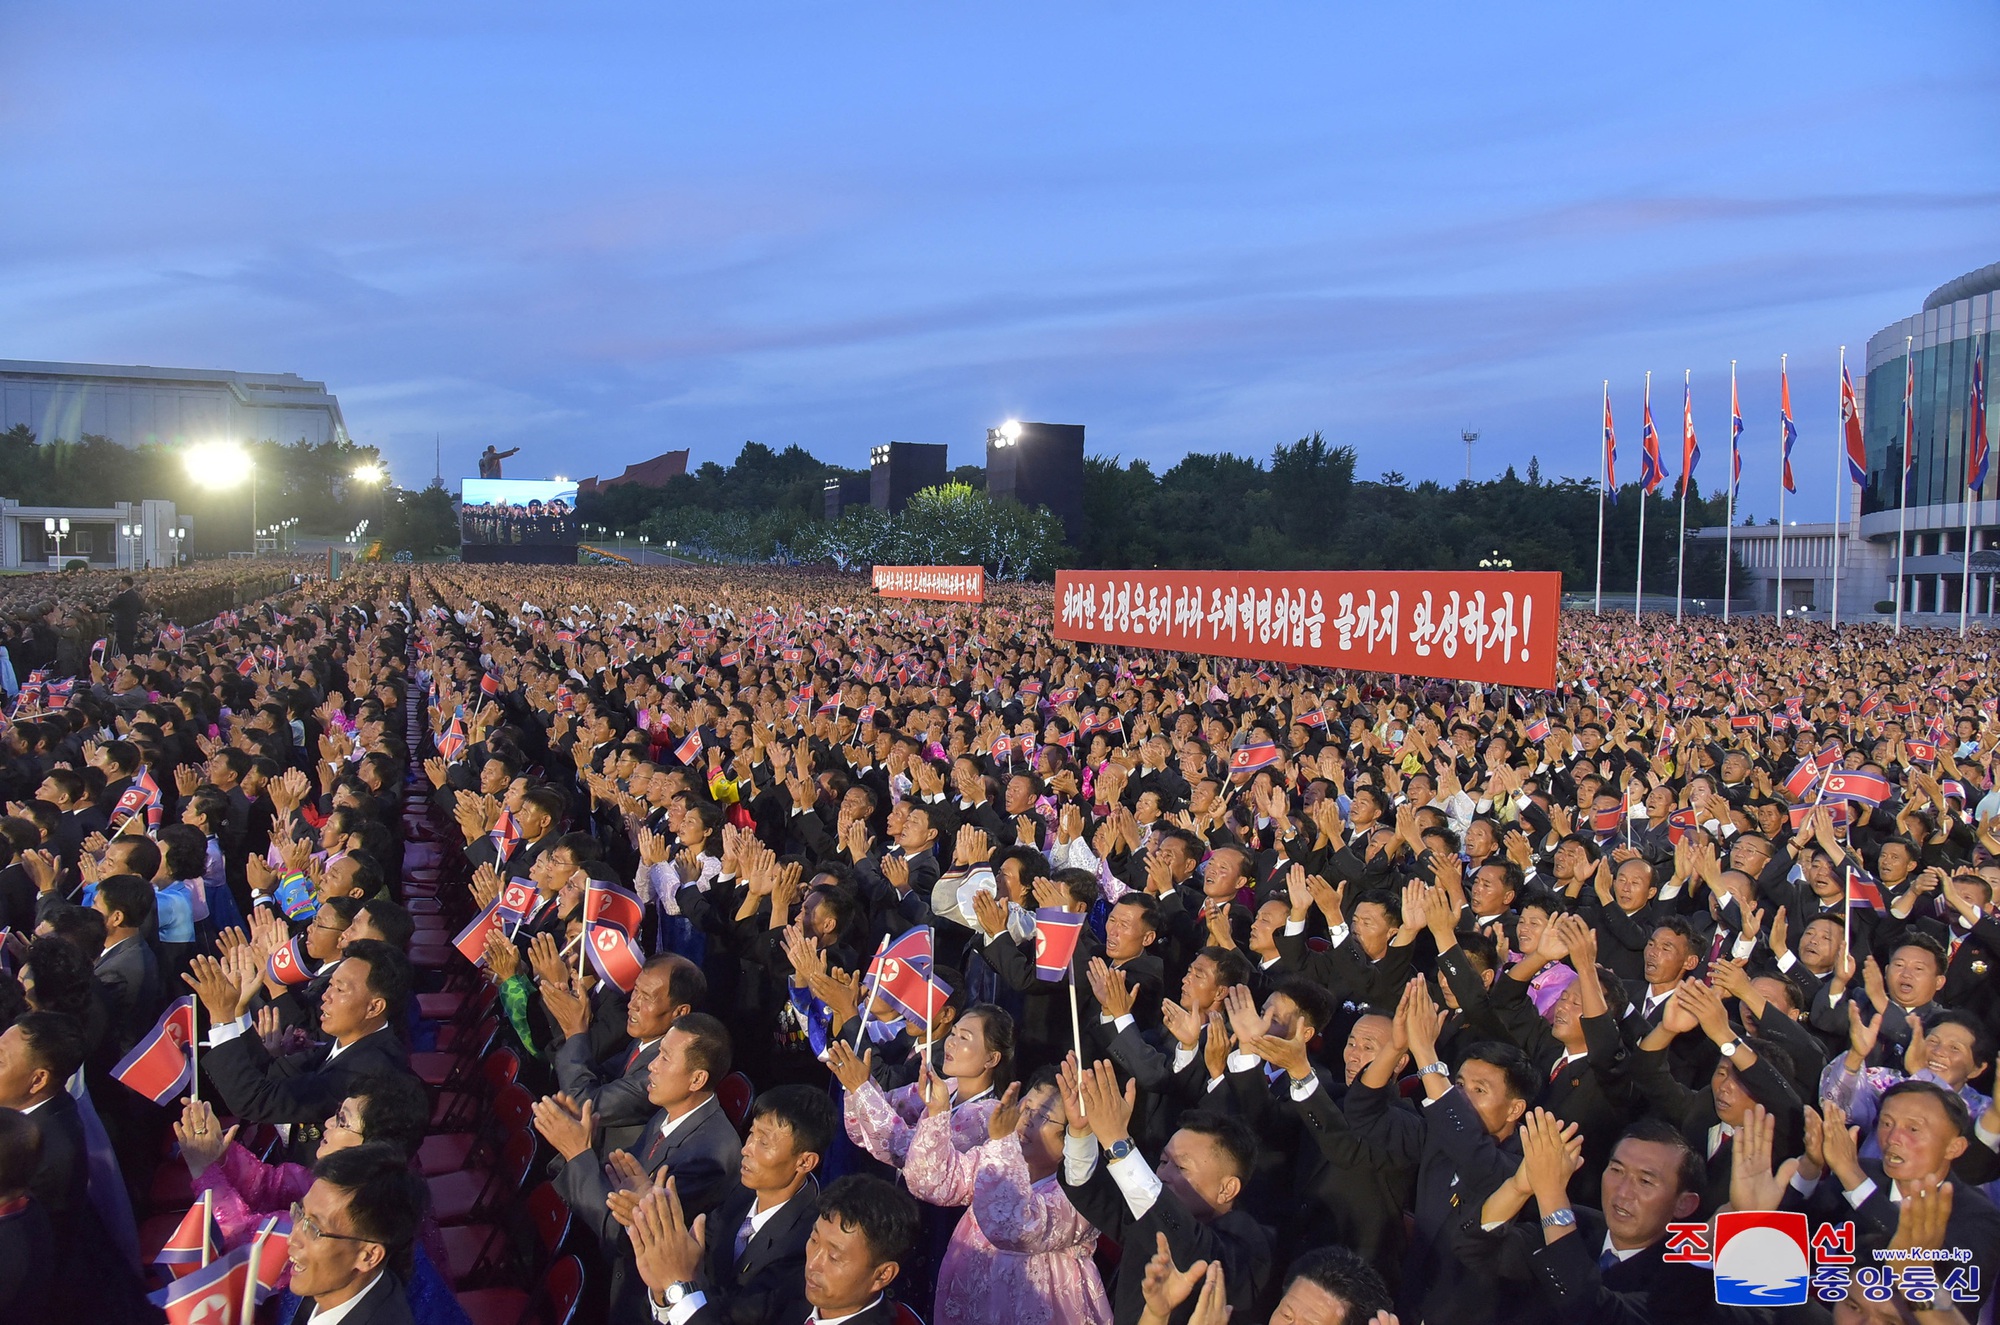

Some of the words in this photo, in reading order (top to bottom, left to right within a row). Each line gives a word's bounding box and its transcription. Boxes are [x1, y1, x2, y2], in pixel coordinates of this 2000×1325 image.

[1061, 582, 1096, 630] 위대한
[1099, 581, 1172, 637] 김정은동지
[1175, 585, 1204, 639] 따라
[1207, 586, 1326, 648] 주체혁명위업을
[1332, 589, 1400, 656] 끝까지
[1409, 590, 1532, 665] 완성하자!
